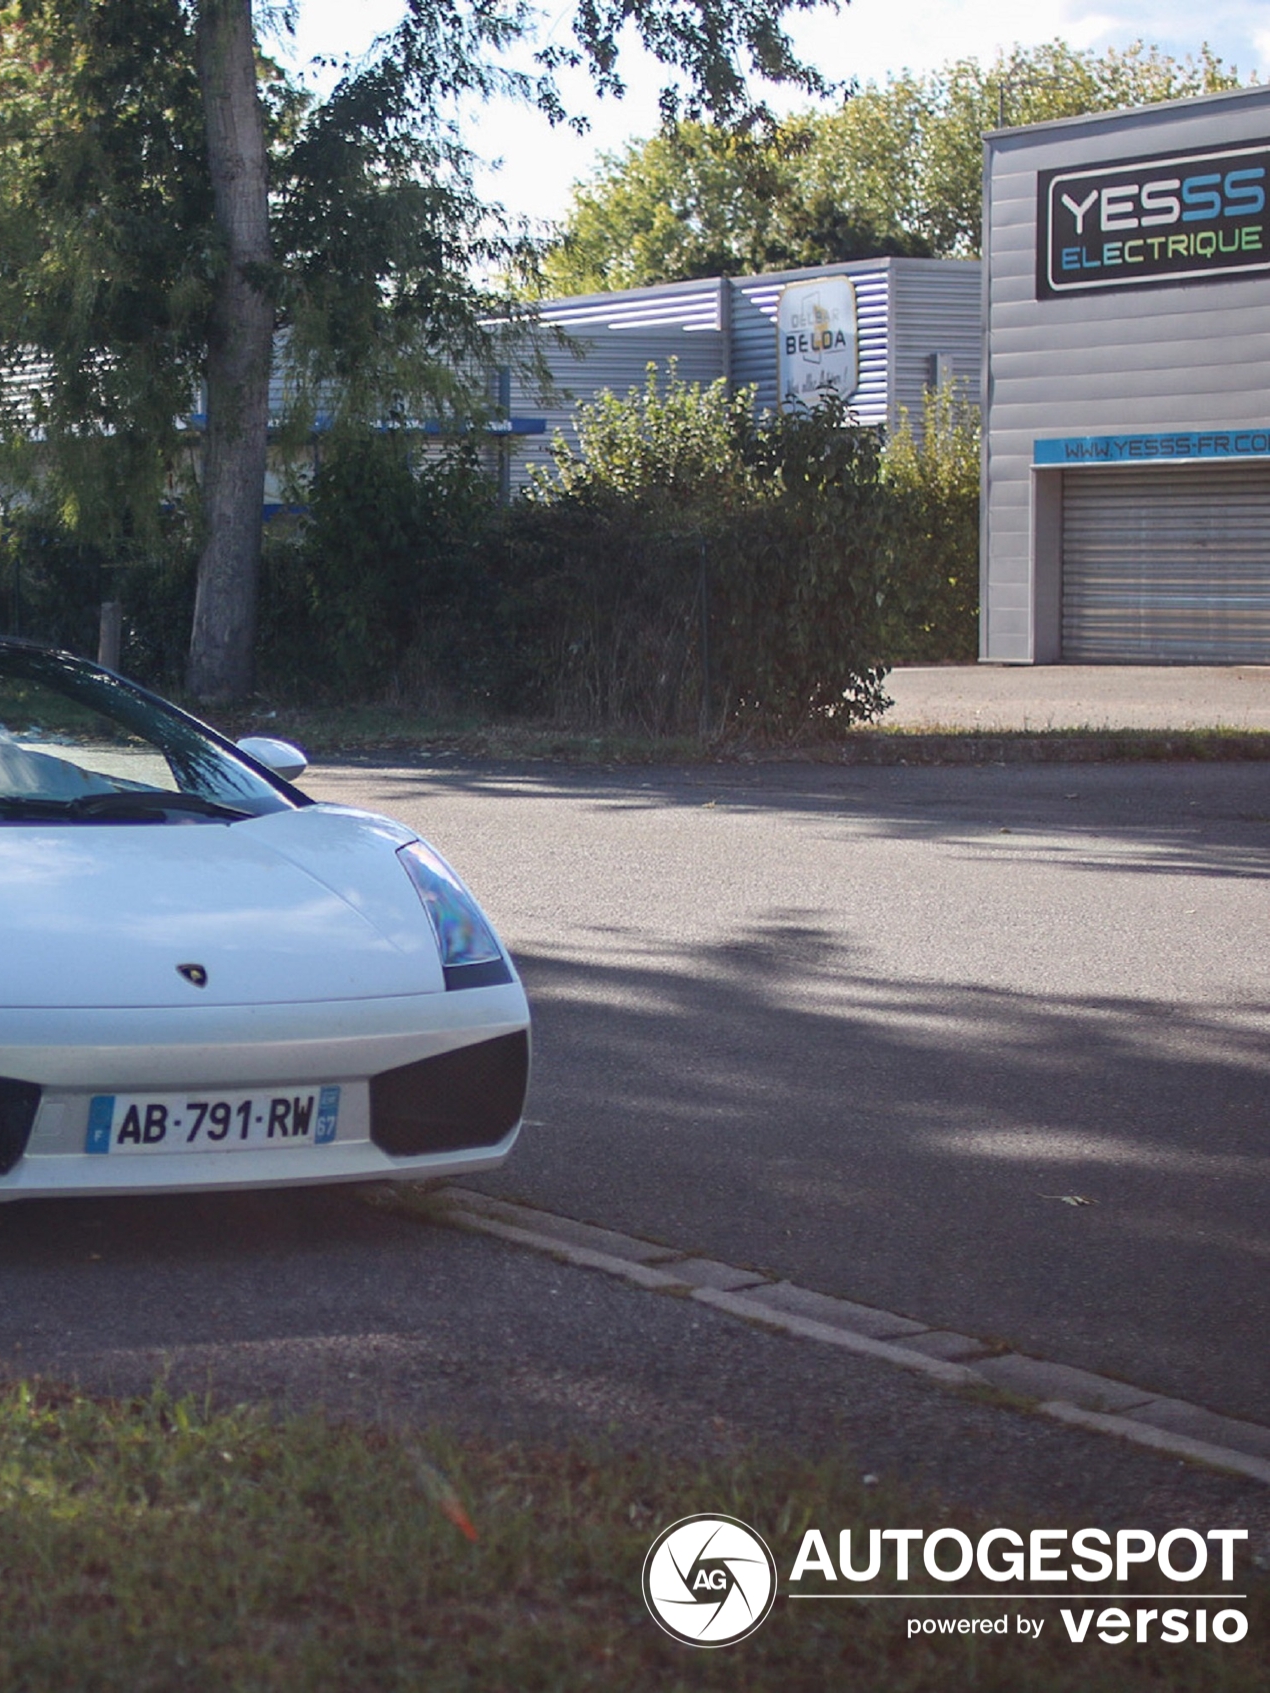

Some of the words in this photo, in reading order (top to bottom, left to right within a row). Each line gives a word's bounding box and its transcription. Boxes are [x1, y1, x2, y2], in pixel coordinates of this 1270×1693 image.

[1061, 168, 1265, 234] YESSS
[1061, 226, 1263, 271] ELECTRIQUE
[785, 328, 846, 355] BELDA
[1065, 434, 1270, 459] WWW.YESSS-FR.CO
[93, 1129, 103, 1142] F
[317, 1115, 336, 1137] 67
